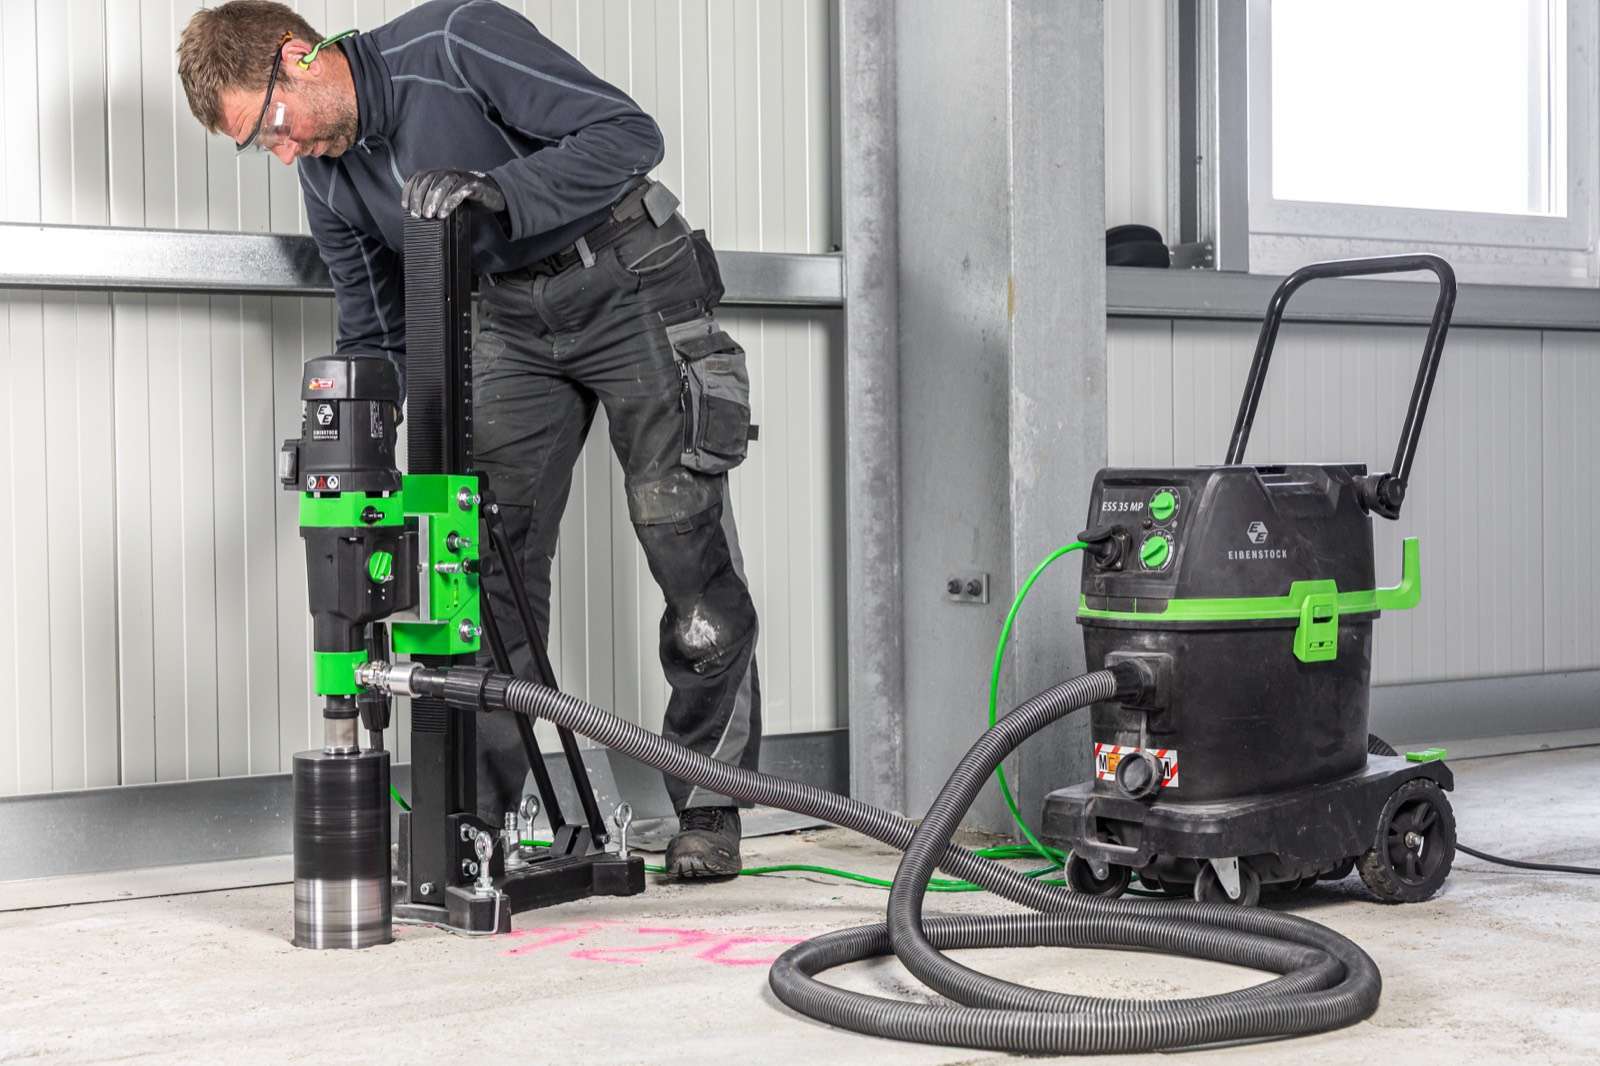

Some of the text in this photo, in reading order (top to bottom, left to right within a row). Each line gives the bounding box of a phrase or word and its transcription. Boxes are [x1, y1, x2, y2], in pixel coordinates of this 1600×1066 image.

[1102, 501, 1144, 512] ESS 35 MP
[1228, 549, 1287, 560] EIBENSTOCK
